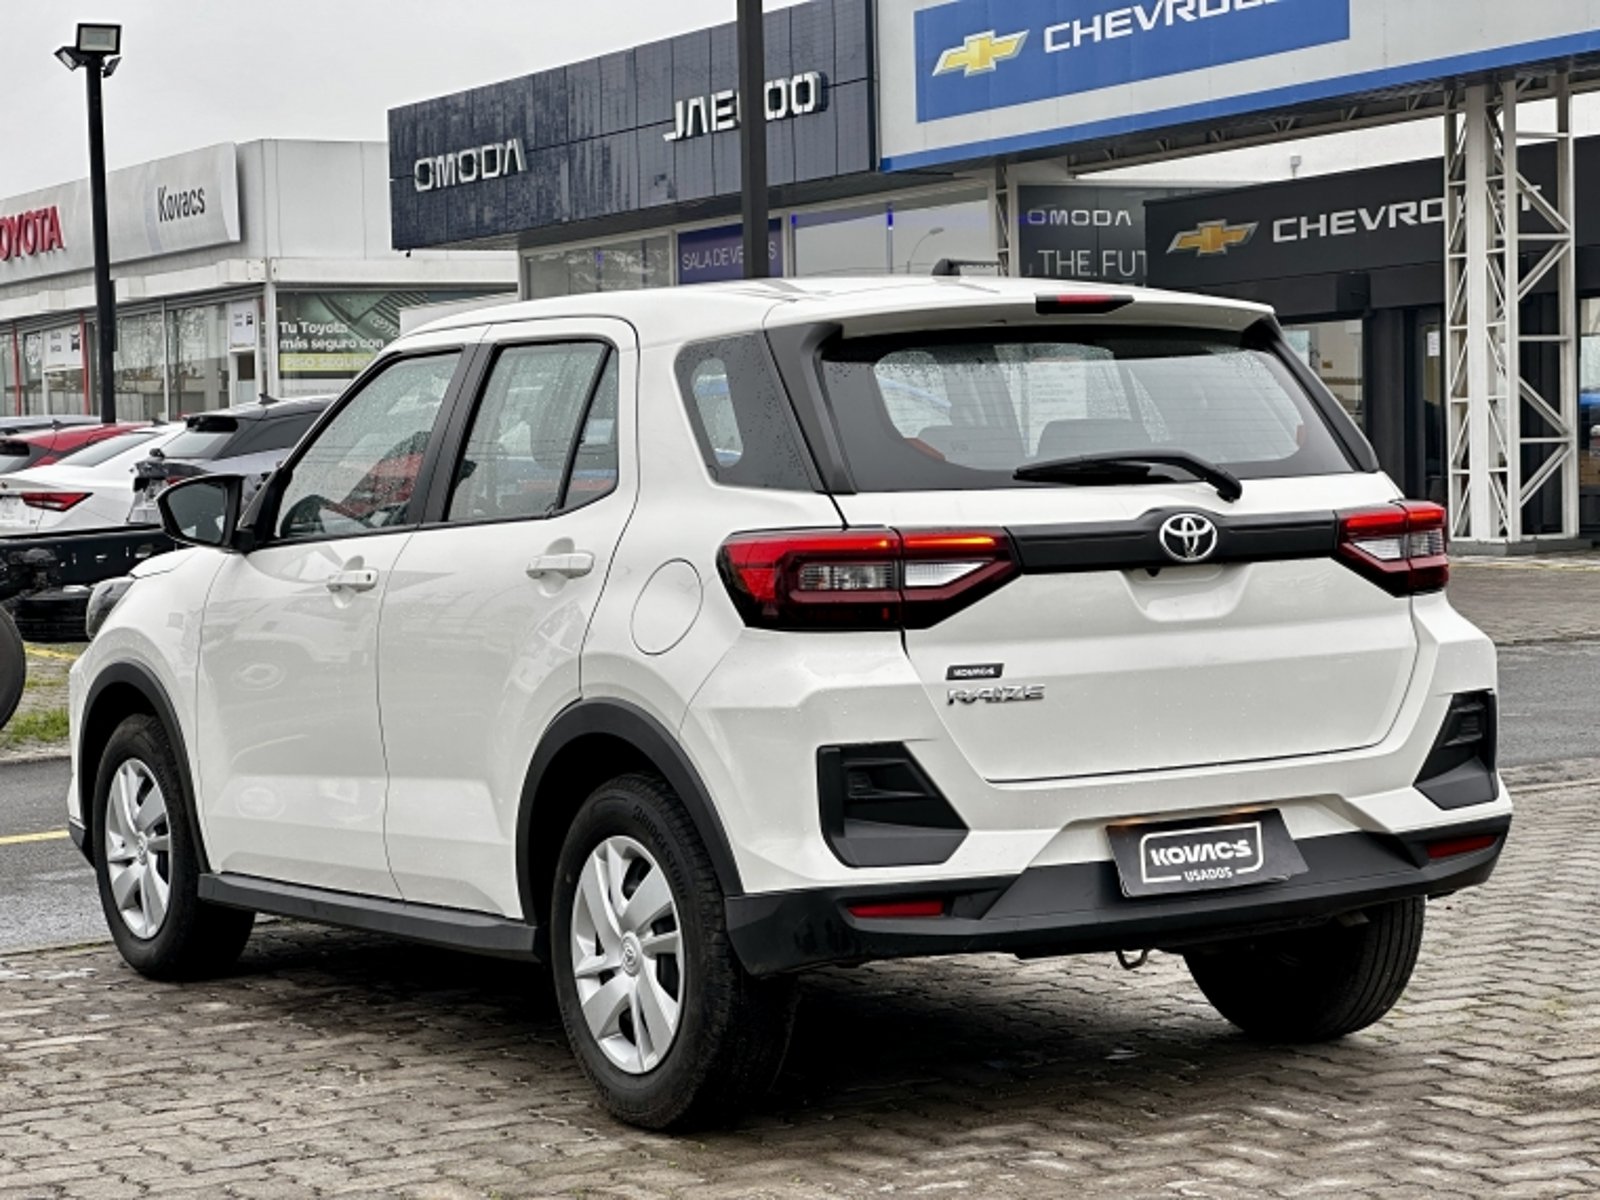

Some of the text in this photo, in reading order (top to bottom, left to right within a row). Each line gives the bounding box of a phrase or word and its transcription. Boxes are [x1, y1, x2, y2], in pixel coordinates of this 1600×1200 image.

[1044, 0, 1281, 53] CHEVRO
[663, 71, 820, 142] JAEOO
[414, 138, 527, 192] OMODA
[157, 186, 205, 222] Kovacs
[1027, 209, 1132, 226] OMODA
[1273, 184, 1542, 243] CHEVROT
[0, 206, 65, 261] OYOTA
[682, 241, 778, 271] SALA DE VES
[280, 321, 348, 336] Tu Toyota
[280, 336, 384, 352] más seguro con
[947, 684, 1045, 706] RAIZE
[1151, 839, 1253, 866] KOVACS
[1183, 866, 1233, 882] USADOS
